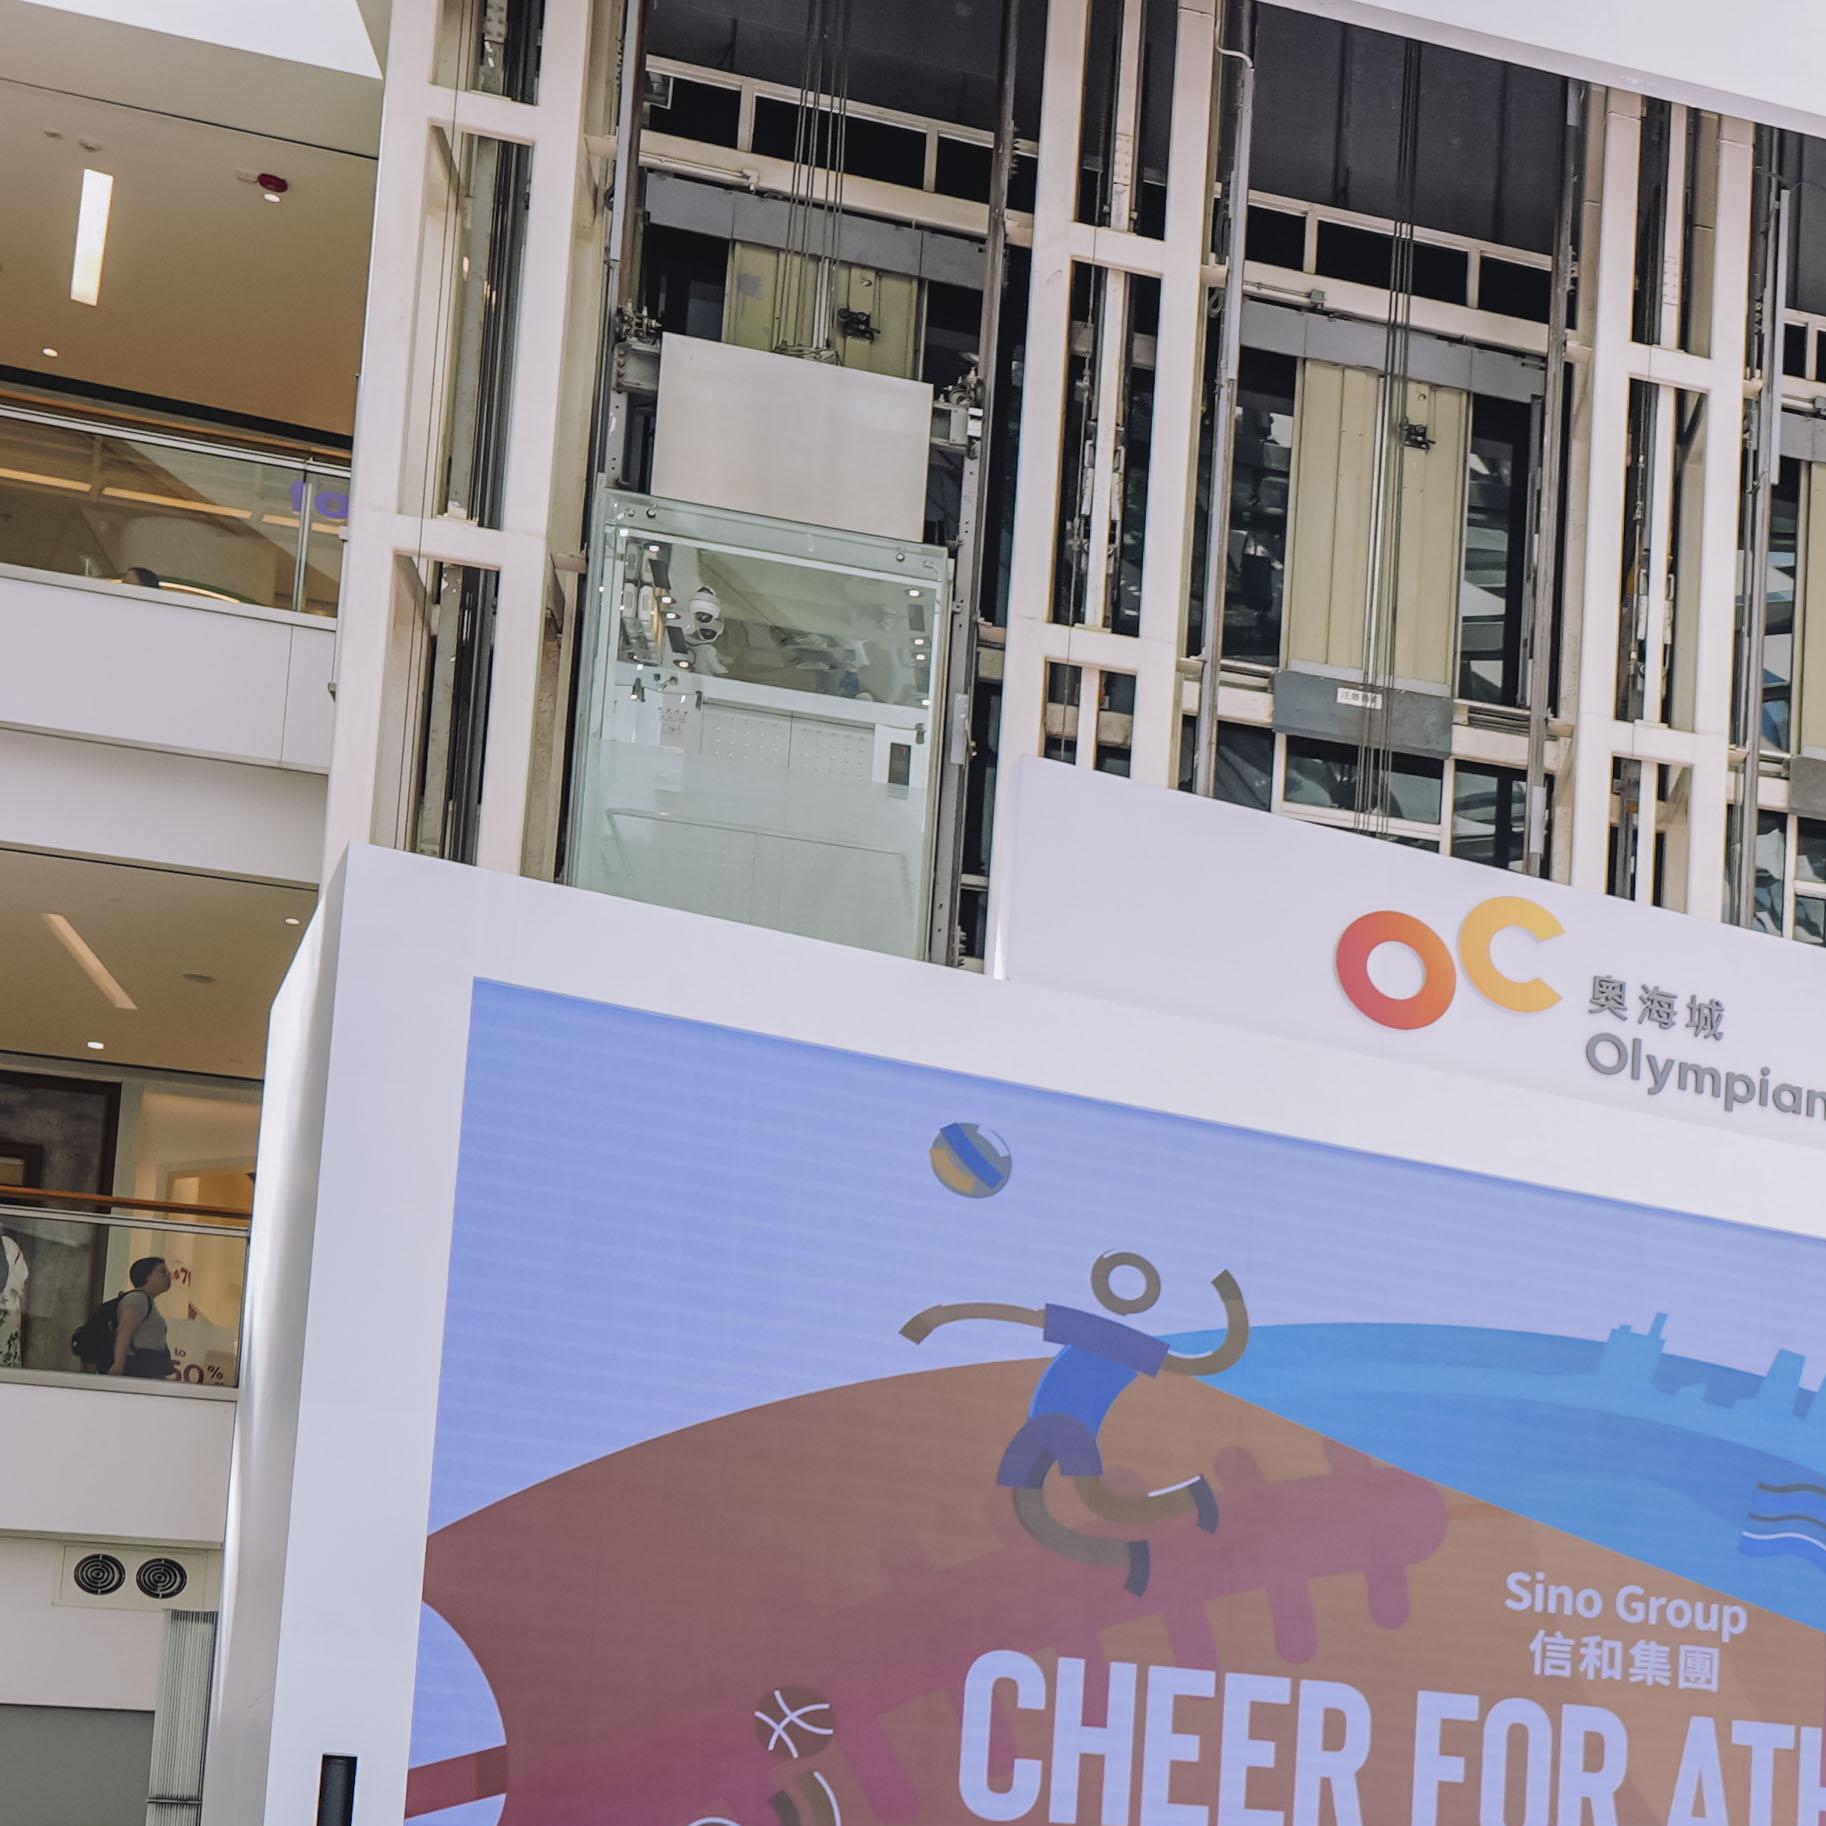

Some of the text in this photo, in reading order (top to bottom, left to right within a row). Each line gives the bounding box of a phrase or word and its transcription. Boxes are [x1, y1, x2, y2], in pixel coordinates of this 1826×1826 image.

[1336, 896, 1564, 1030] OC
[1504, 1571, 1748, 1643] Sino Group
[1528, 1629, 1720, 1693] 信和集團
